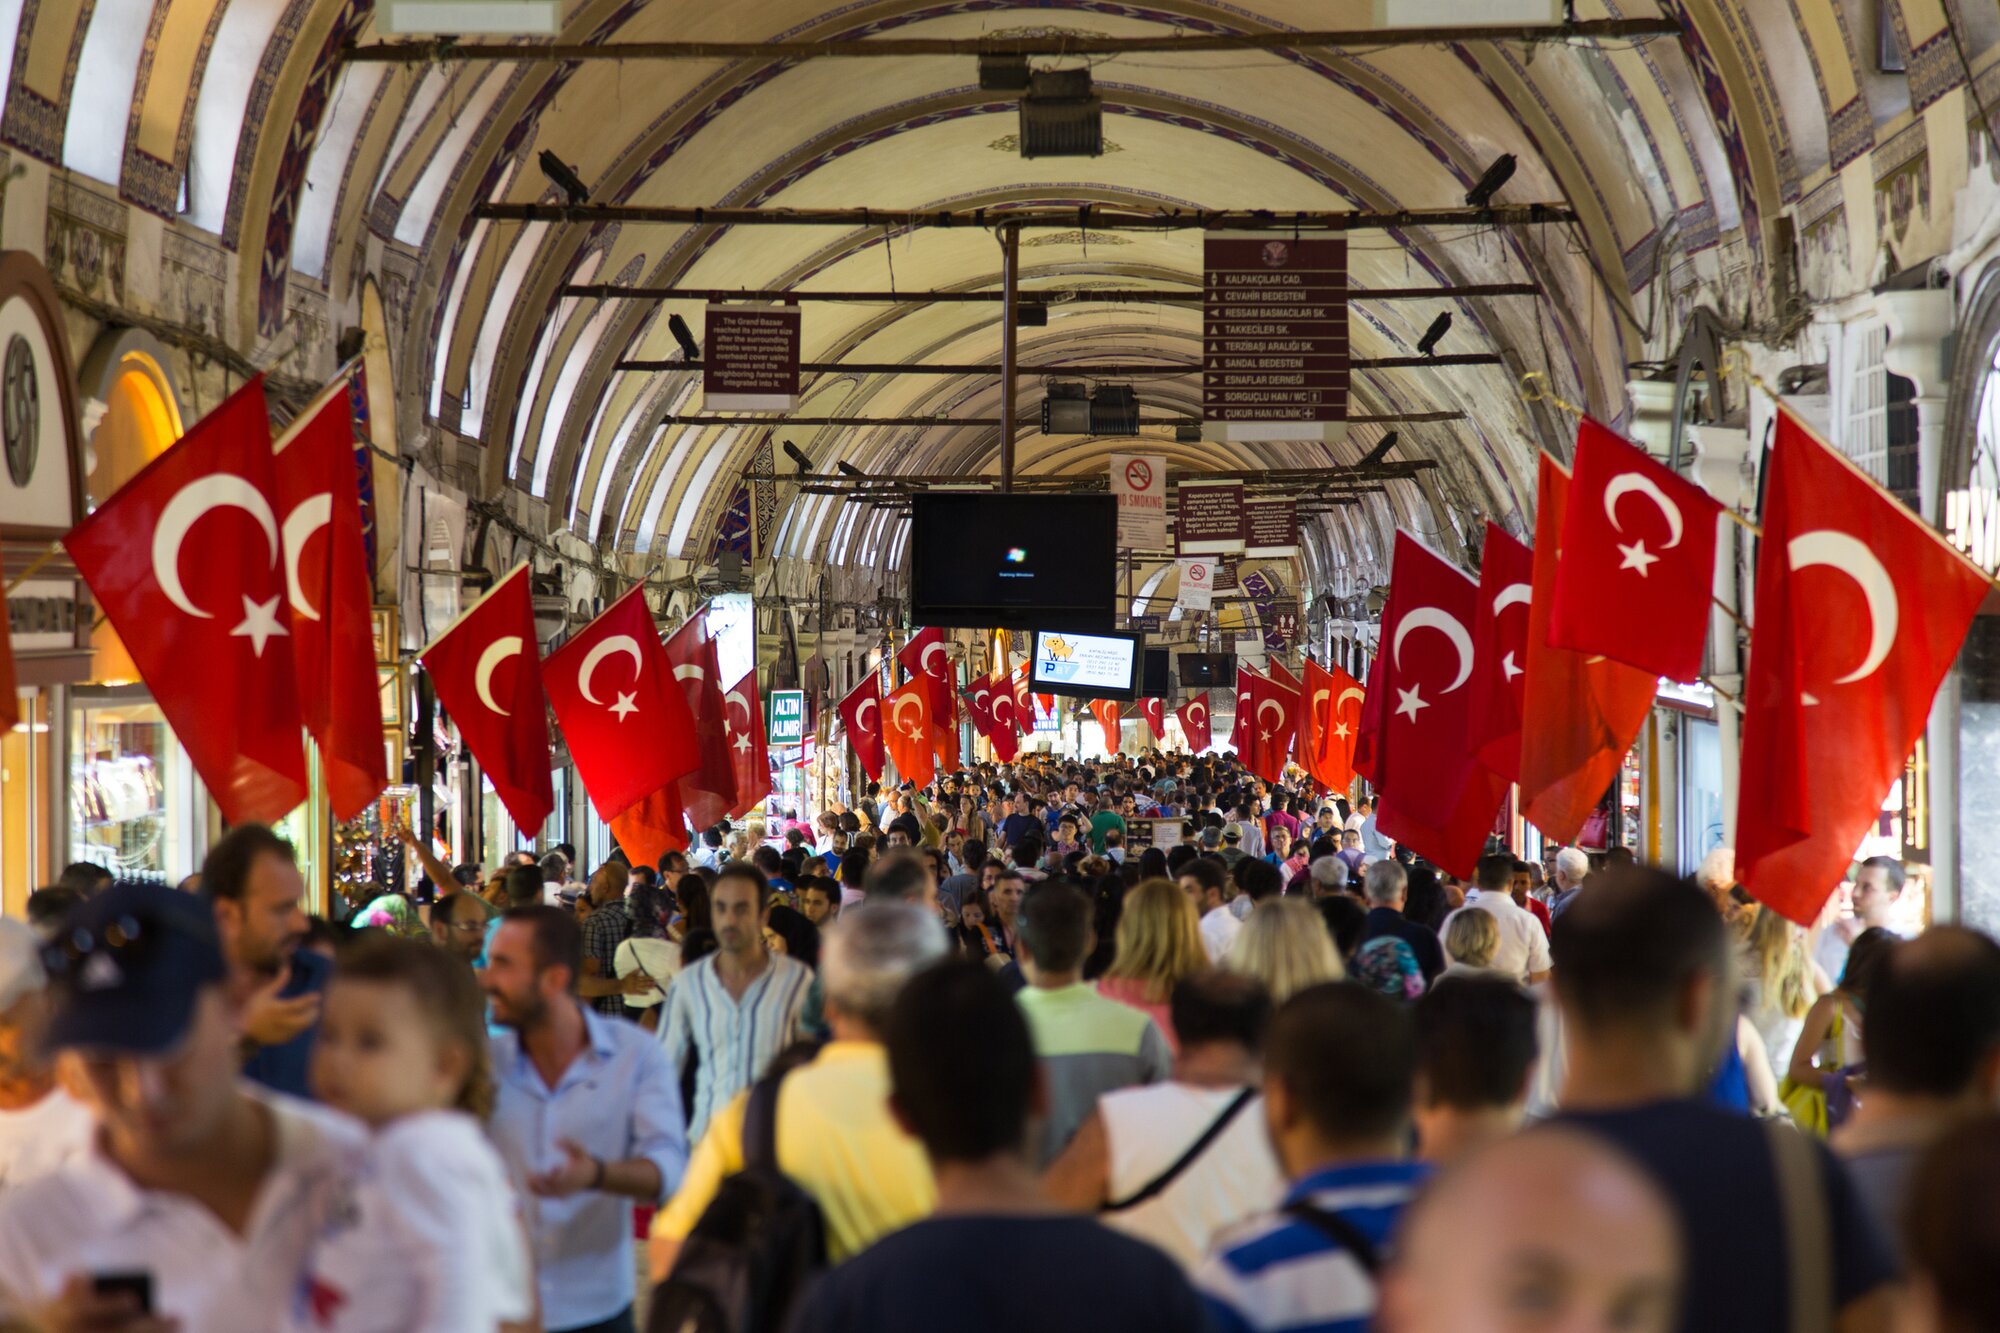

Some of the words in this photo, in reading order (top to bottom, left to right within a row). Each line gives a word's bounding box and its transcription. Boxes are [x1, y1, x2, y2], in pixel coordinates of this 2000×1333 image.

[1225, 275, 1280, 285] KALPAKÇILAR
[1283, 275, 1301, 284] CAD.
[1225, 291, 1260, 300] CEVAHİR
[1262, 291, 1306, 300] BEDESTENİ
[1225, 308, 1258, 317] RESSAM
[1260, 308, 1312, 317] BASMACILAR
[1314, 308, 1327, 317] SK.
[1225, 323, 1275, 334] TAKKECİLER
[1277, 325, 1289, 334] SK.
[1225, 341, 1266, 352] TERZİBAŞI
[1268, 341, 1300, 351] ARALIĞI
[1302, 342, 1314, 351] SK.
[1225, 359, 1258, 367] SANDAL
[1259, 357, 1303, 367] BEDESTENİ
[1225, 376, 1267, 384] ESNAFLAR
[1269, 374, 1304, 384] DERNEĞİ
[1225, 392, 1270, 402] SORGUÇLU
[1225, 409, 1253, 420] ÇUKUR
[1130, 494, 1162, 509] SMOKING
[775, 699, 799, 715] ALTIN
[773, 720, 800, 736] ALINIR
[1033, 720, 1058, 729] LINIR
